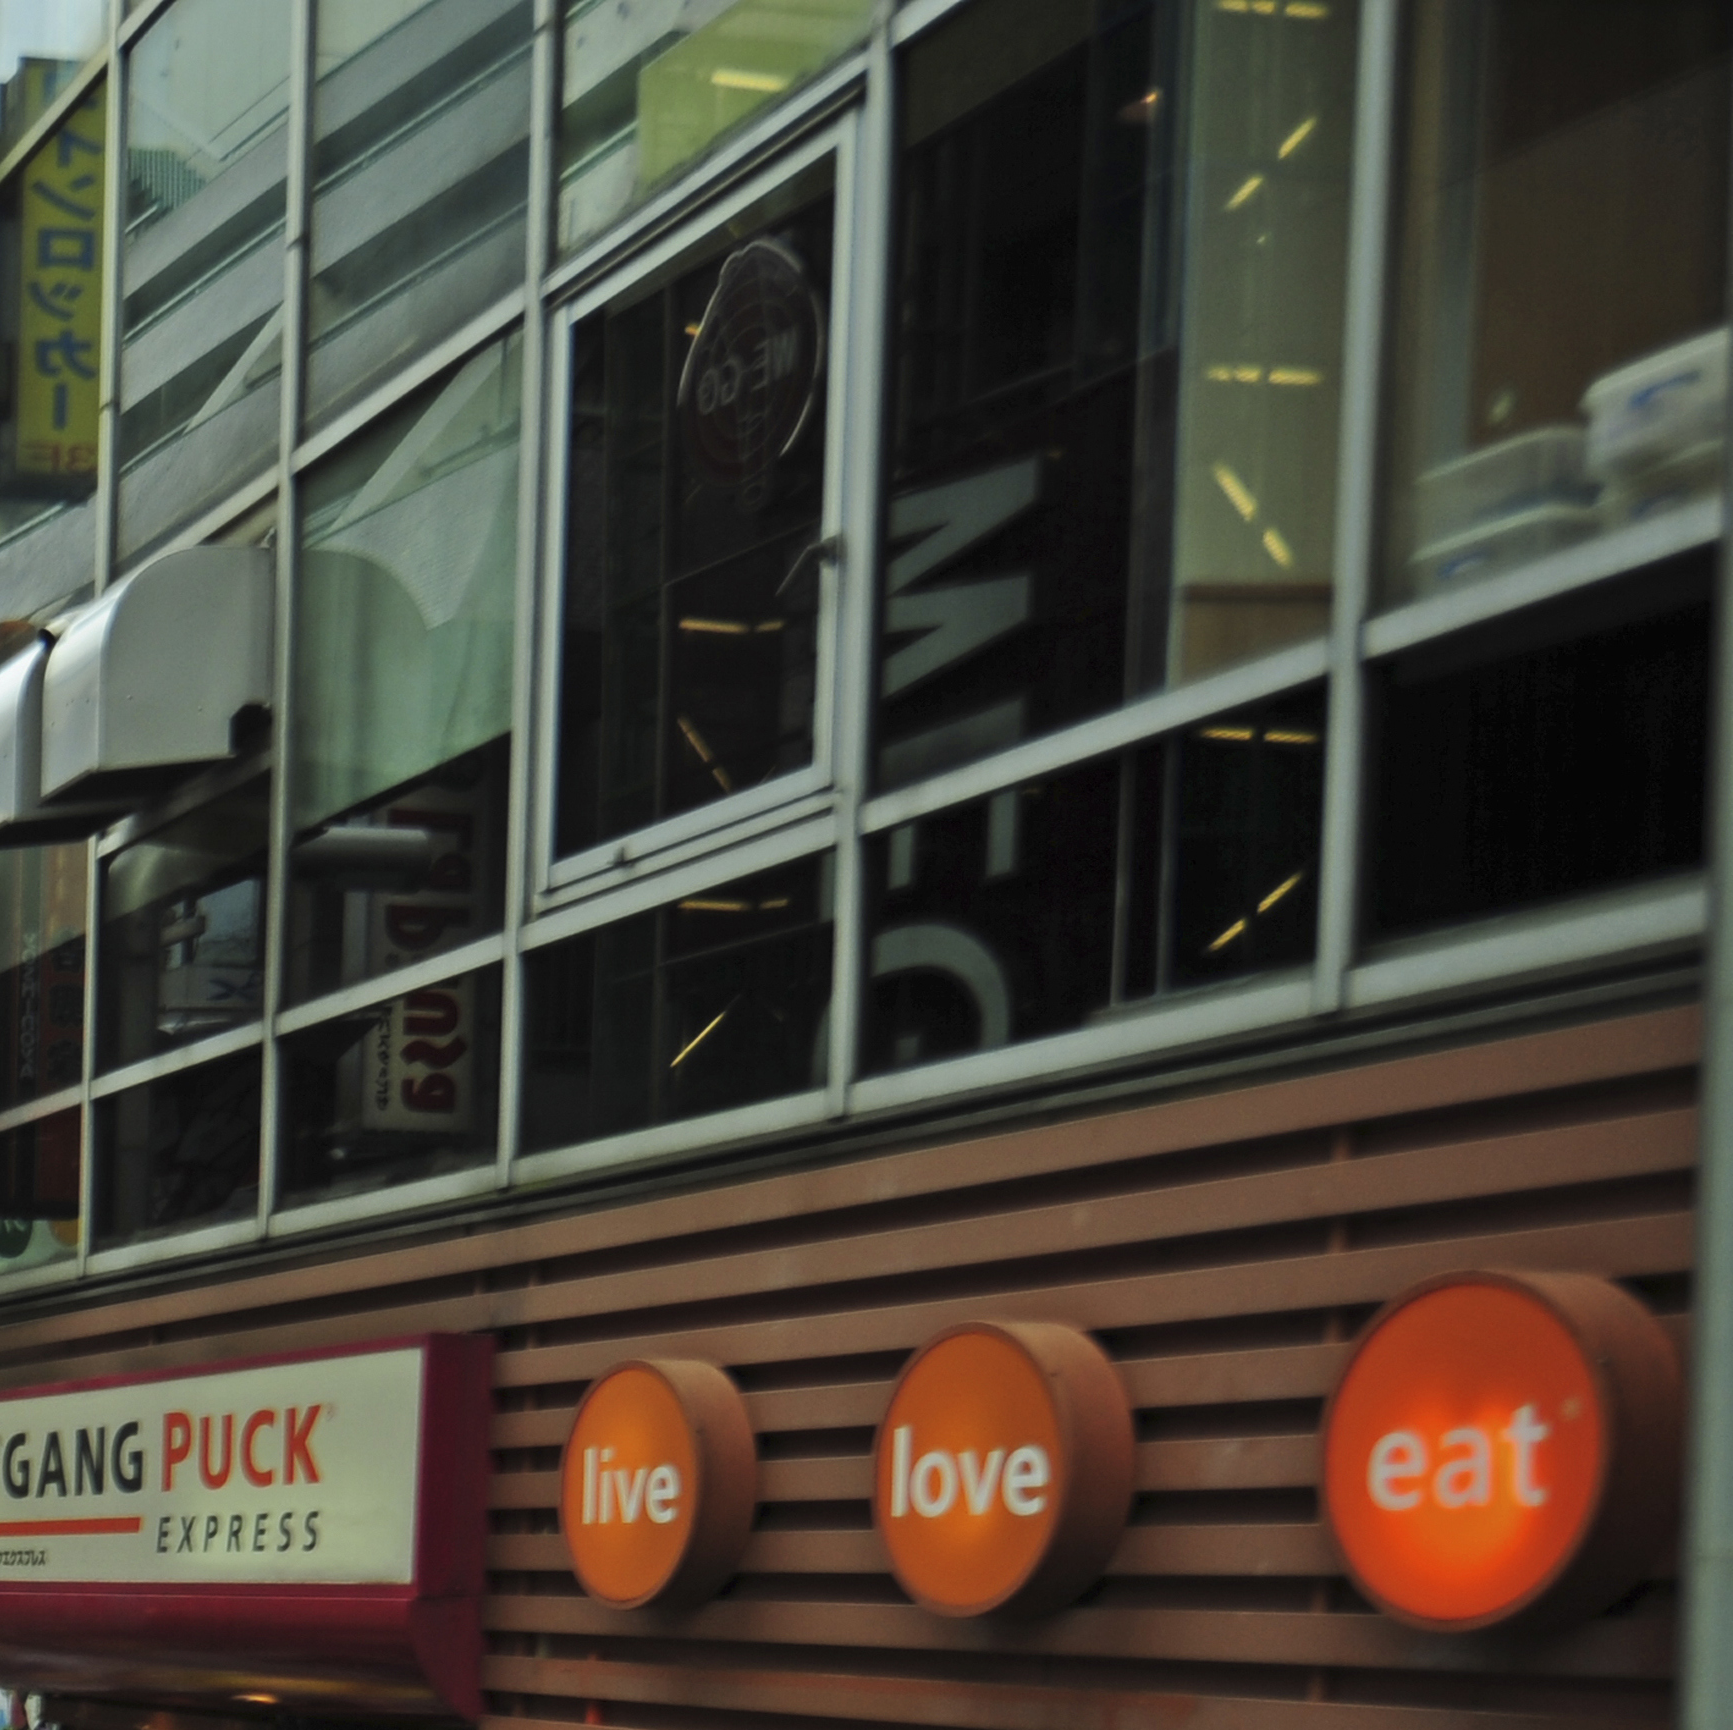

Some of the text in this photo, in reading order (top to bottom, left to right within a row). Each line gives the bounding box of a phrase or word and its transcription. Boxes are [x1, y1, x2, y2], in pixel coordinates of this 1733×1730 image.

[161, 1403, 323, 1493] PUCK
[581, 1448, 681, 1524] live
[890, 1425, 1051, 1519] love
[1367, 1403, 1548, 1509] eat
[156, 1510, 322, 1555] EXPRESS
